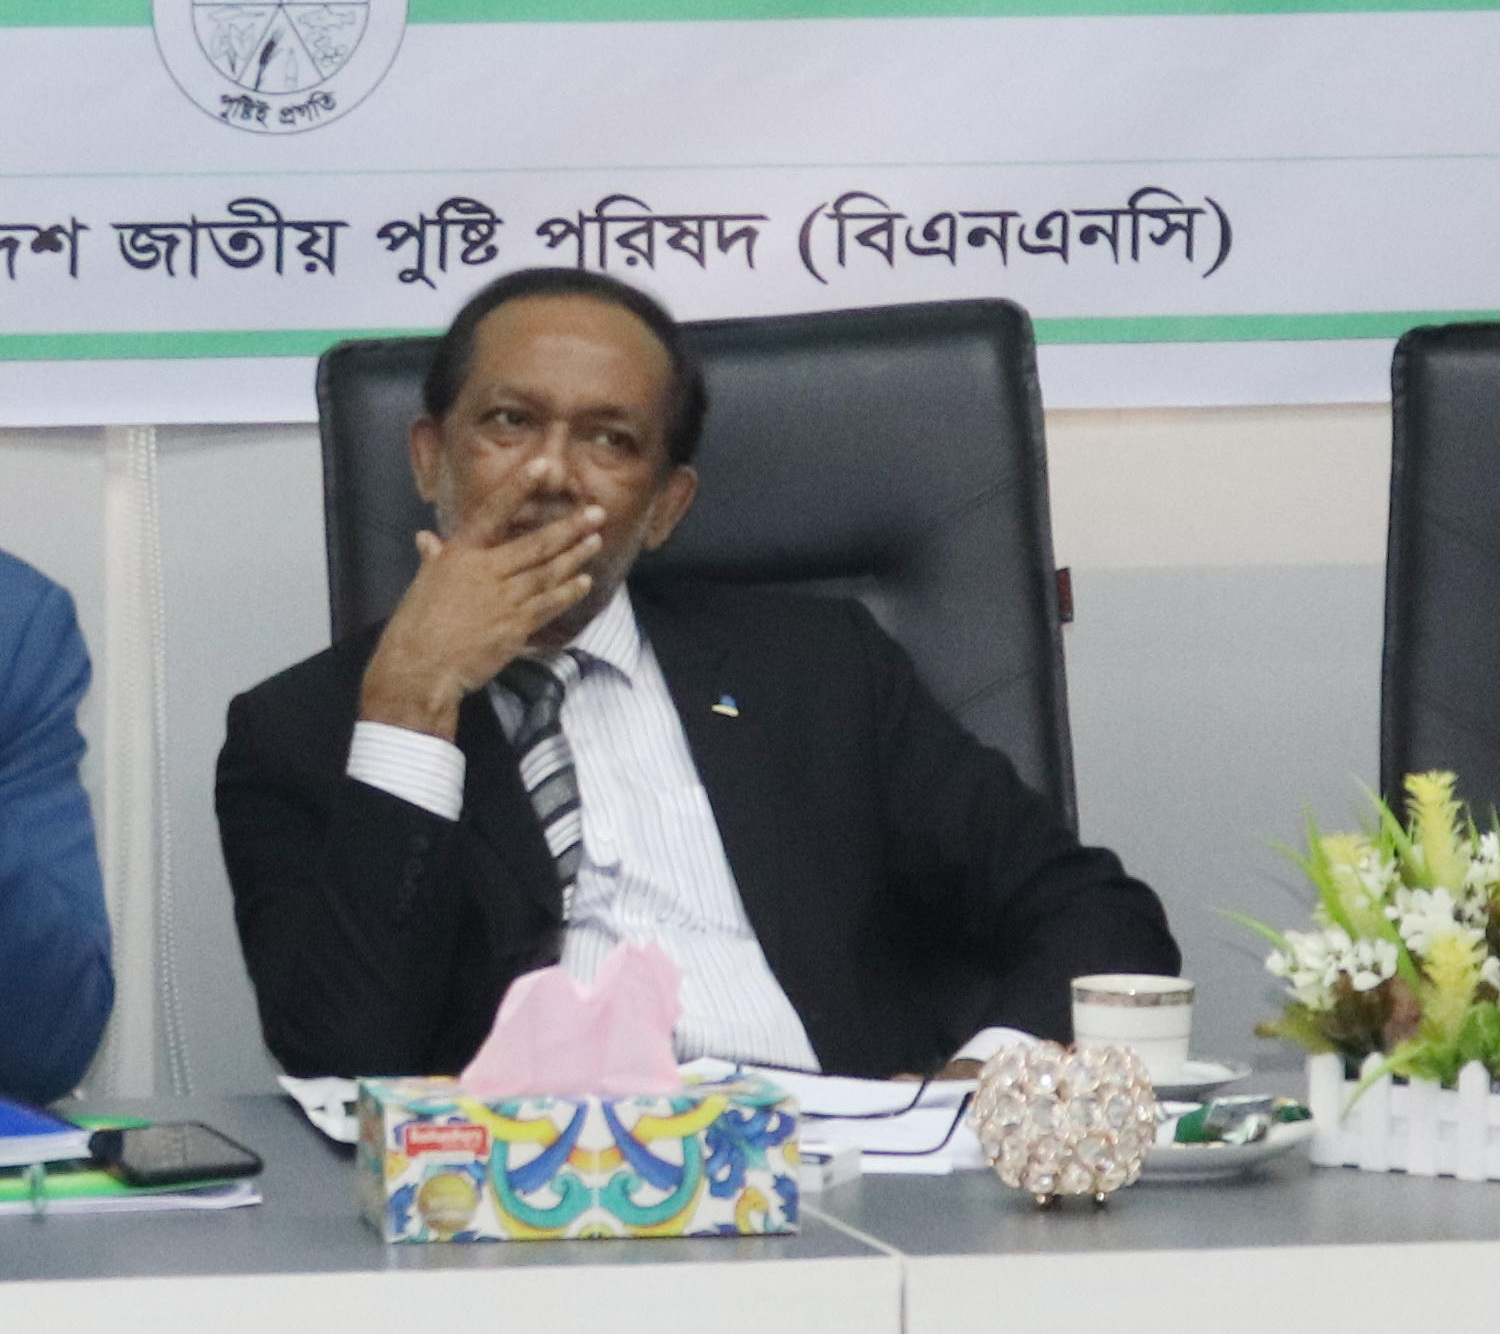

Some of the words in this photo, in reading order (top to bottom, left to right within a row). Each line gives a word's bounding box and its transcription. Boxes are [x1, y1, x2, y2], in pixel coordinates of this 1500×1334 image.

[110, 197, 350, 278] জাতীয়
[376, 196, 505, 285] পুষ্টি
[535, 193, 769, 269] পরিষদ
[799, 186, 1232, 284] (বিএনএনসি)
